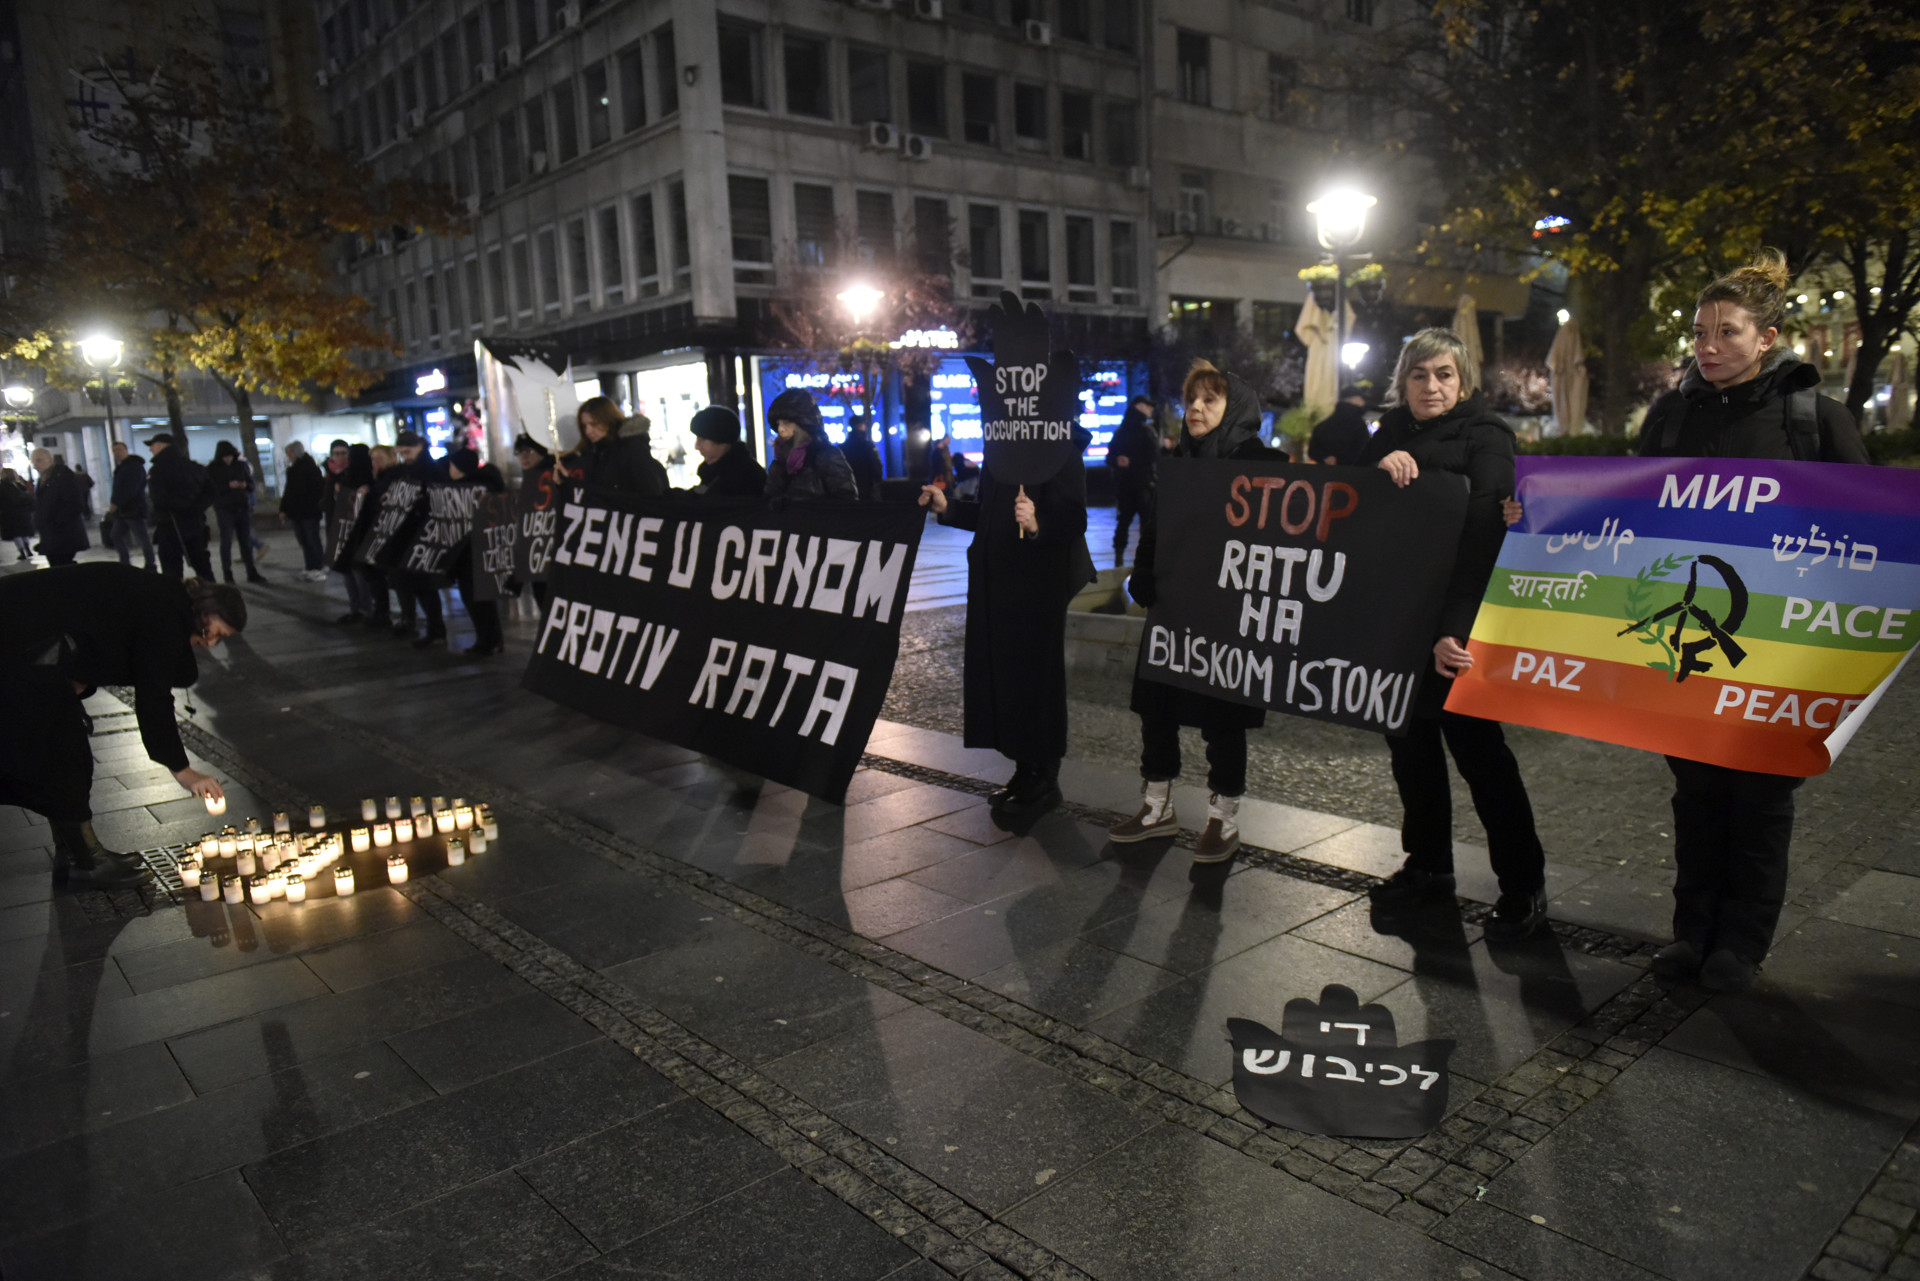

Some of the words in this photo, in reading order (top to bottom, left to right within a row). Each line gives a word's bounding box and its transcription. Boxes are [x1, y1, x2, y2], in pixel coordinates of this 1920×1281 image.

[995, 363, 1048, 394] STOP
[1004, 396, 1039, 417] THE
[984, 420, 1071, 441] OCCUPATION
[1225, 475, 1359, 542] STOP
[1658, 474, 1781, 513] МИР
[554, 488, 664, 583] ŽENE
[668, 521, 702, 589] U
[711, 525, 908, 624] CRNOM
[1218, 540, 1346, 602] RATU
[1239, 593, 1303, 646] NA
[1780, 596, 1912, 640] PACE
[537, 597, 680, 690] PROTIV
[689, 637, 858, 747] RATA
[1511, 651, 1586, 691] PAZ
[1320, 1021, 1371, 1046] די
[1243, 1048, 1440, 1091] לכיבוש
